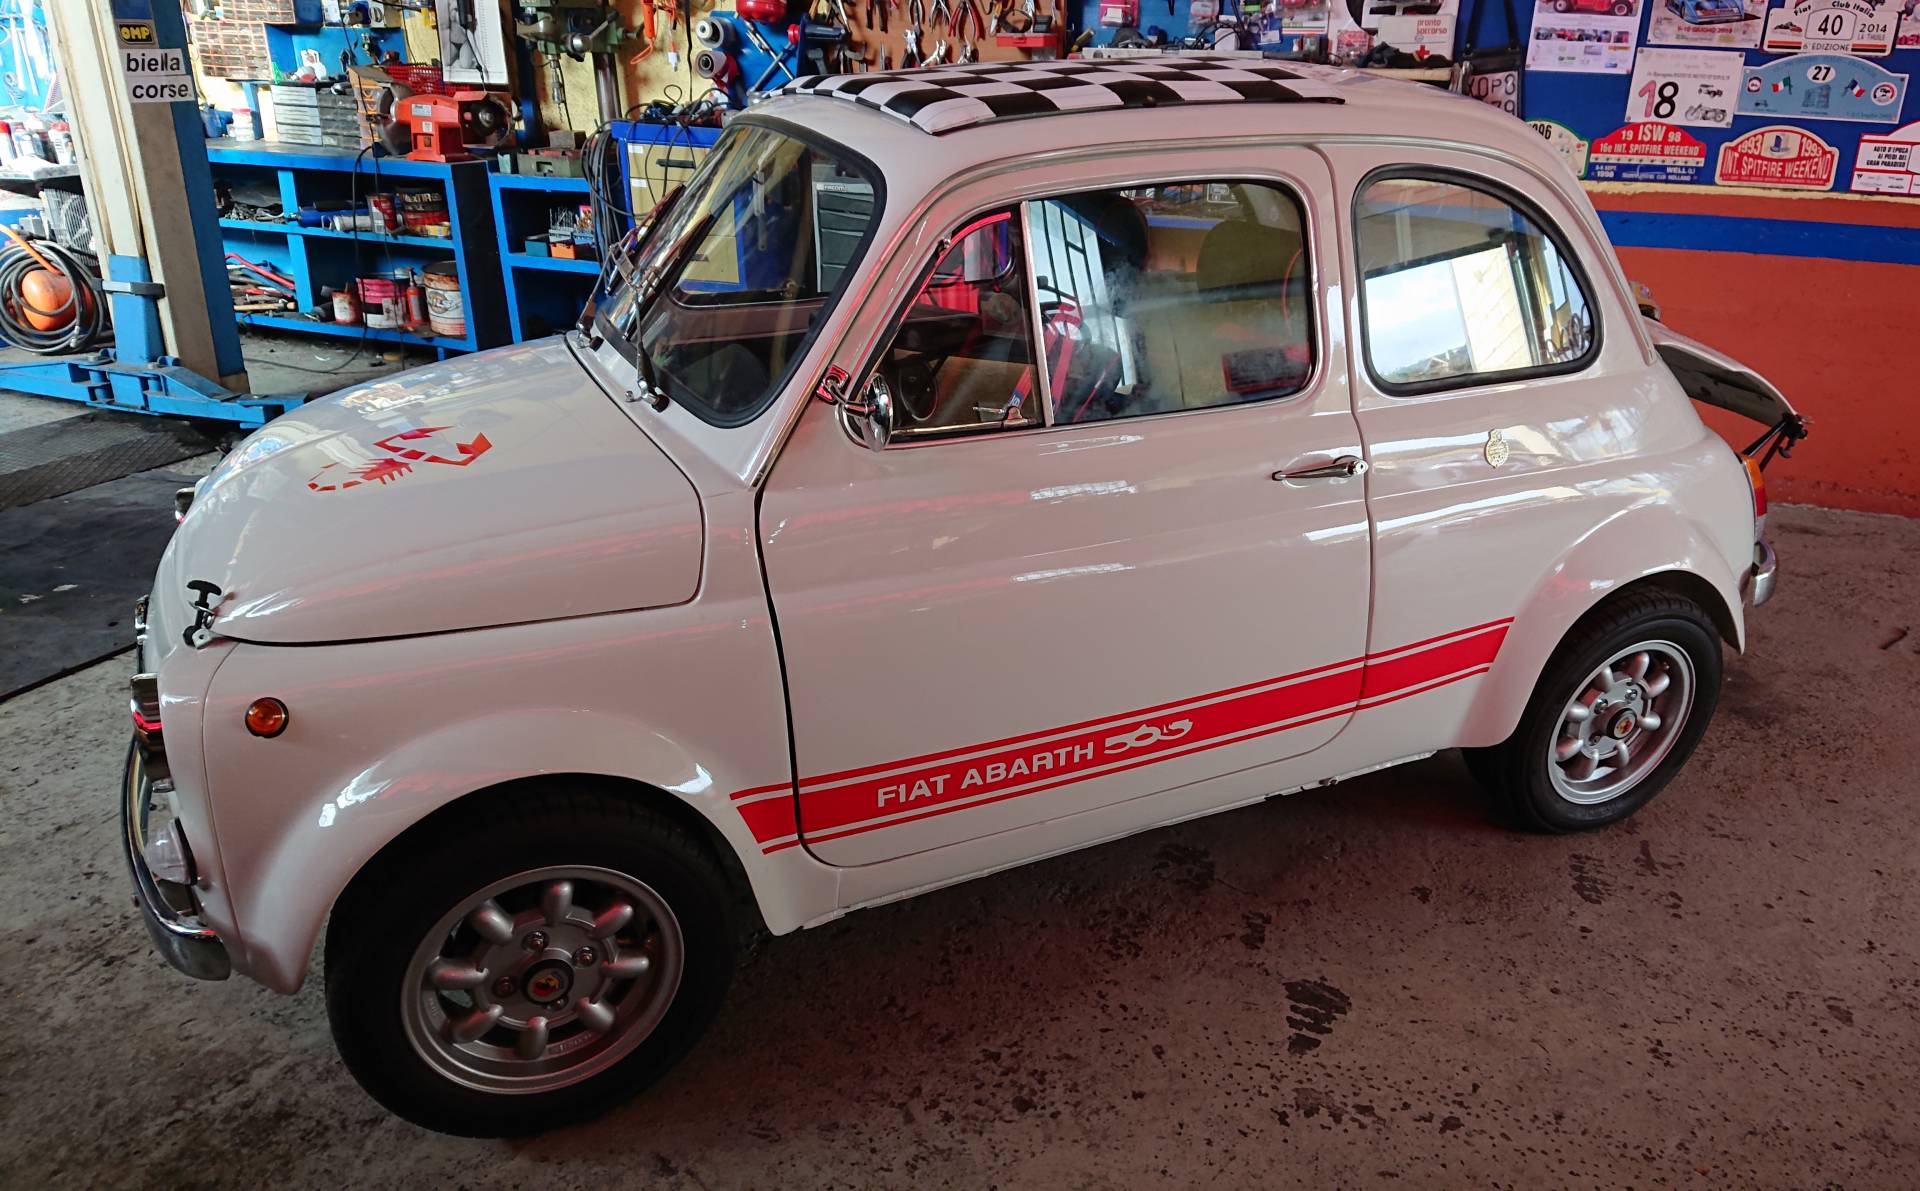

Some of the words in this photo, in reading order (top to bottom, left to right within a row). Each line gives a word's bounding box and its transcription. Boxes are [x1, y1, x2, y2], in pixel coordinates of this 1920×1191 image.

[1794, 5, 1812, 16] Fiat
[1853, 3, 1875, 19] Italia
[121, 26, 150, 40] OMP
[1817, 14, 1844, 36] 40
[1859, 23, 1888, 33] 2014
[1811, 43, 1850, 51] EDIZIONE
[126, 52, 181, 72] biella
[1812, 66, 1832, 81] 27
[132, 83, 189, 99] corse
[1638, 80, 1679, 119] 18
[1621, 130, 1634, 140] 19
[1638, 124, 1666, 141] ISW
[1668, 132, 1682, 142] 98
[1614, 143, 1627, 153] INT.
[1629, 144, 1662, 155] SPITFIRE
[1664, 145, 1700, 156] WEEKEND
[1801, 137, 1823, 157] 1993
[1722, 148, 1739, 175] INT.
[1741, 156, 1783, 177] SPITFIRE
[1784, 153, 1832, 180] WEEKEND
[877, 774, 951, 808] FIAT
[960, 741, 1095, 790] ABARTH
